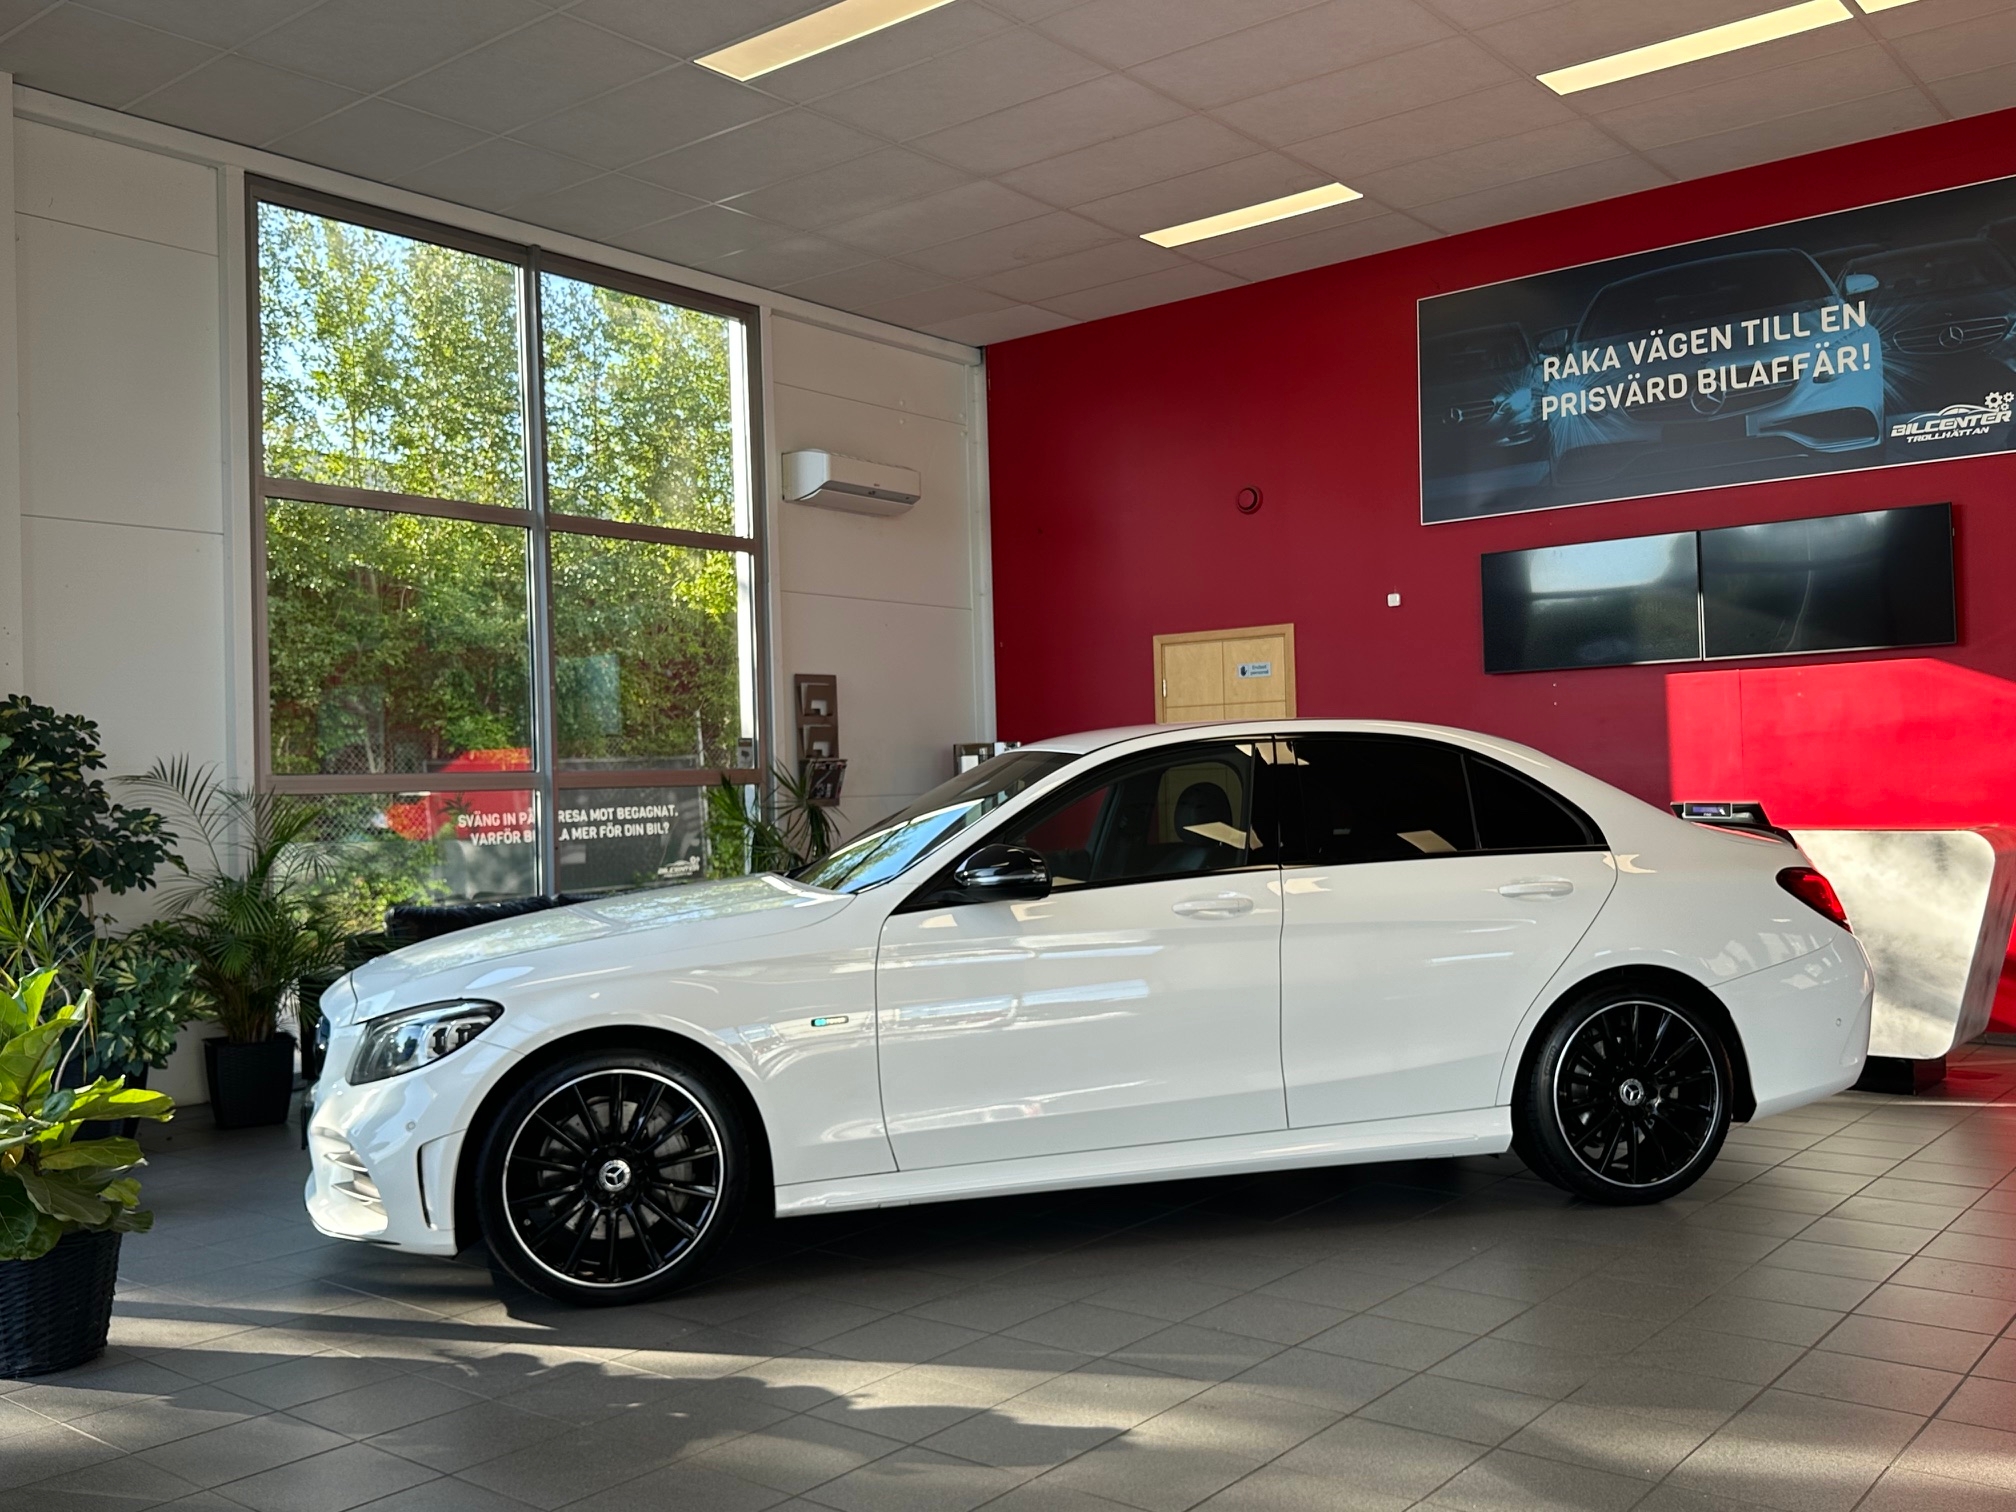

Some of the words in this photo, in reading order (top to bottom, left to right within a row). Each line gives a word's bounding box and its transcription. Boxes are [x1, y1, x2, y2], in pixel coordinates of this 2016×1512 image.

[1543, 345, 1621, 382] RAKA
[1627, 324, 1732, 365] VÄGEN
[1741, 312, 1811, 346] TILL
[1820, 300, 1867, 333] EN
[1541, 372, 1687, 421] PRISVÄRD
[1697, 341, 1871, 394] BILAFFÄR!
[1890, 410, 2012, 437] BILCENTER
[1906, 426, 1990, 443] TROLLHÄTTAN
[457, 810, 501, 829] SVÄNG
[502, 812, 517, 826] IN
[558, 809, 588, 823] RESA
[590, 807, 614, 822] MOT
[616, 804, 679, 820] BEGAGNAT.
[470, 827, 522, 847] VARFÖR
[571, 825, 598, 840] MER
[599, 821, 622, 839] FÖR
[624, 823, 645, 837] DIN
[646, 821, 670, 836] BIL?
